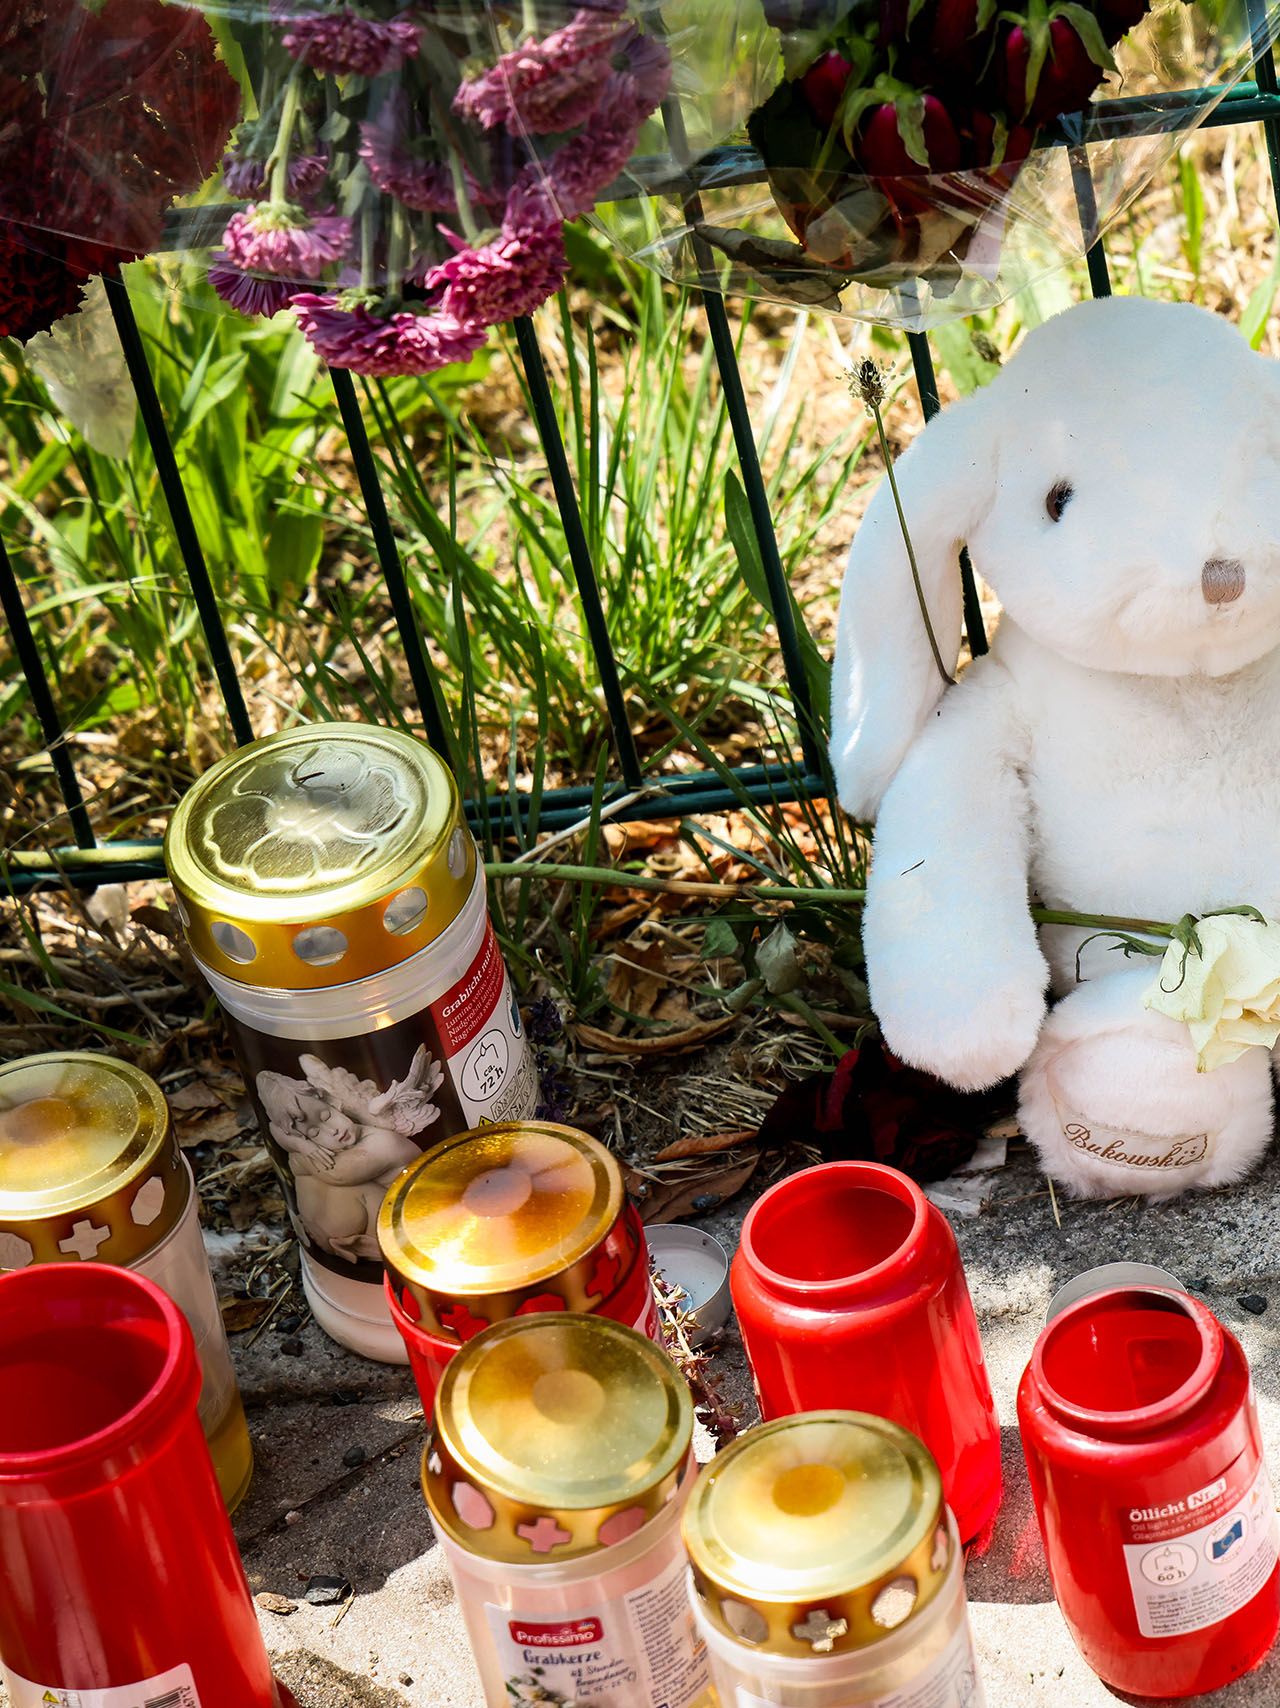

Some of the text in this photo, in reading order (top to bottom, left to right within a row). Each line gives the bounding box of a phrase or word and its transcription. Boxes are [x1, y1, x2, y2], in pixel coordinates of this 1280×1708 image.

[442, 970, 482, 1018] Grablicht
[445, 1002, 472, 1030] Lumino
[448, 1001, 482, 1038] Nadgrobni
[451, 1011, 484, 1047] Nagrobna
[480, 1066, 504, 1095] 72 h
[484, 1064, 496, 1077] ca.
[1065, 1123, 1184, 1168] Bukowski
[1129, 1501, 1186, 1522] Öllicht
[1157, 1573, 1175, 1582] 60
[516, 1630, 594, 1645] Profissimo
[522, 1649, 601, 1665] Grabkerze
